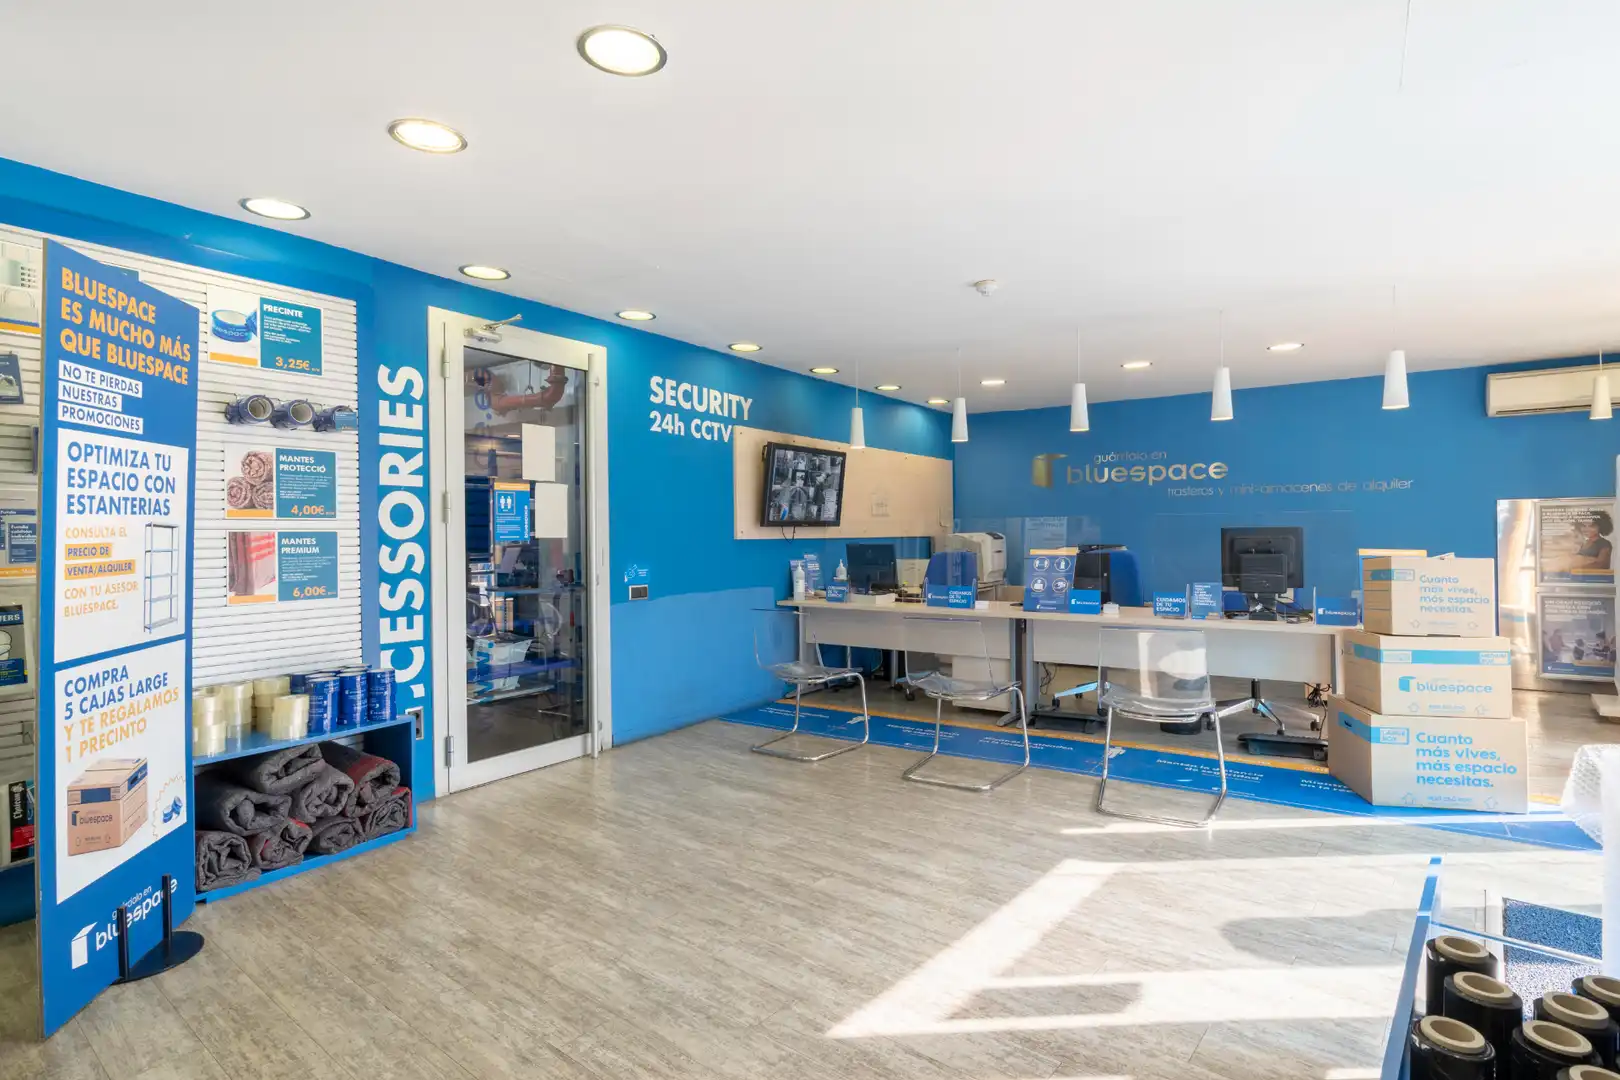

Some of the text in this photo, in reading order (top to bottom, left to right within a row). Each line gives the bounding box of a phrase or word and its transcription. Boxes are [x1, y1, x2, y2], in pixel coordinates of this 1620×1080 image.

[61, 267, 156, 325] BLUESPACE
[263, 303, 303, 318] PRECINTE
[61, 297, 191, 362] ES MUCHO MÁS
[60, 328, 188, 385] QUE BLUESPACE
[275, 356, 310, 372] 3,25€
[62, 364, 140, 394] NO TE PIERDAS
[62, 385, 118, 408] NUESTRAS
[649, 375, 753, 420] SECURITY
[62, 405, 140, 431] PROMOCIONES
[649, 410, 733, 443] 24h CCTV
[67, 441, 171, 472] OPTIMIZA TU
[279, 455, 314, 464] MANTES
[279, 463, 326, 473] PROTECCIÓ
[1067, 461, 1228, 486] bluespace
[67, 467, 176, 494] ESPACIO CON
[1167, 485, 1214, 498] trasteros
[1338, 480, 1357, 492] de
[1362, 478, 1415, 493] alquiler
[67, 494, 170, 516] ESTANTERIAS
[291, 505, 325, 516] 4,00€
[66, 526, 127, 539] CONSULTA EL
[377, 364, 425, 699] CESSORIES
[67, 546, 109, 557] PRECIO DE
[281, 546, 320, 554] PREMIUM
[67, 562, 133, 576] VENTA/ALQUILER
[1419, 575, 1459, 584] Cuanto
[64, 581, 139, 600] CON TU ASESOR
[293, 585, 326, 598] 6,00€
[1447, 595, 1490, 605] espacio
[1448, 586, 1478, 595] vives,
[1419, 605, 1475, 614] necesitas.
[64, 664, 129, 698] COMPRA
[1416, 681, 1493, 695] bluespace
[64, 672, 168, 720] 5 CAJAS LARGE
[64, 687, 180, 741] Y TE REGALAMOS
[65, 717, 148, 763] 1 PRECINTO
[1415, 732, 1473, 745] Cuanto
[1415, 746, 1501, 762] más vives,
[1415, 760, 1517, 775] más espacio
[1415, 774, 1494, 788] necesitas.
[96, 878, 178, 951] bluespae
